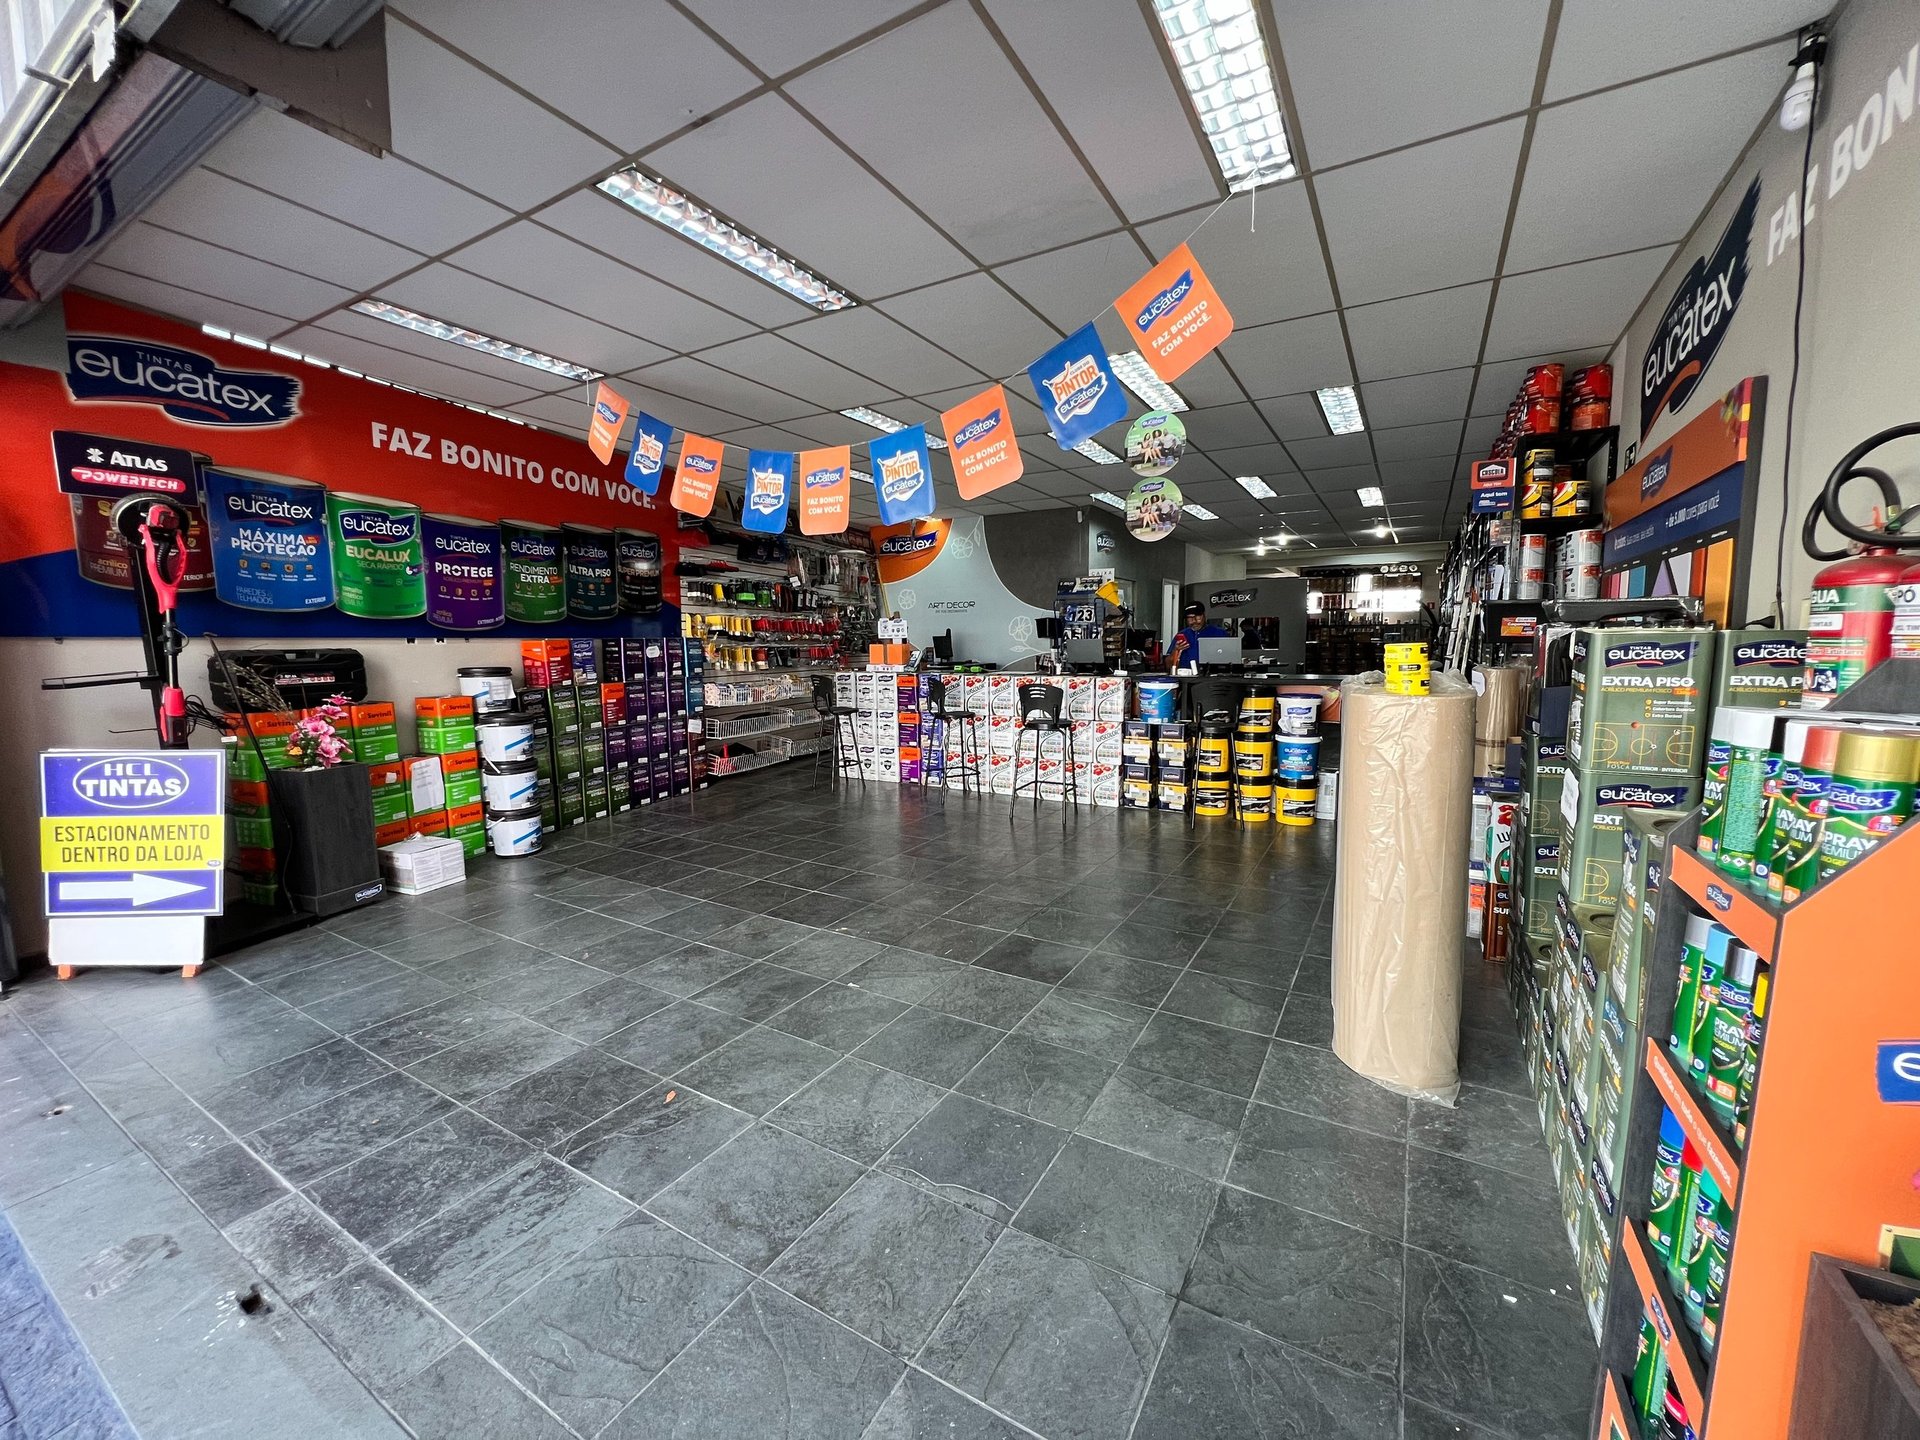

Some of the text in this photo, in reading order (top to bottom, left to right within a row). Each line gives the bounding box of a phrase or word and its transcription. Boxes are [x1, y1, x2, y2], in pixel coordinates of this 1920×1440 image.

[1767, 43, 1920, 266] FAZ BON
[1138, 281, 1190, 326] eucatex
[1152, 300, 1208, 348] FAZ BONITO
[1645, 256, 1737, 397] eucatex
[1160, 336, 1183, 357] COM
[137, 351, 193, 372] TINTAS
[75, 348, 275, 417] eucatex
[1053, 365, 1099, 402] PINTOR
[1060, 384, 1101, 415] eucatex
[955, 417, 998, 444] eucatex
[110, 451, 168, 471] ATLAS
[371, 421, 433, 461] FAZ
[440, 438, 545, 485] BONITO
[550, 467, 600, 497] COM
[960, 440, 1007, 468] FAZ BONITO
[806, 472, 841, 484] eucatex
[885, 462, 919, 483] PINTOR
[965, 463, 985, 477] COM
[82, 469, 179, 491] POWERTECH
[756, 480, 782, 494] PINTOR
[886, 478, 918, 493] eucatex
[228, 496, 313, 520] eucatex
[753, 496, 779, 505] eucatex
[343, 516, 411, 536] eucatex
[239, 528, 307, 546] MÁXIMA
[435, 537, 491, 554] eucatex
[882, 539, 932, 552] eucatex
[345, 544, 411, 563] EUCALUX
[510, 541, 556, 556] eucatex
[571, 545, 608, 558] eucatex
[621, 546, 655, 558] eucatex
[434, 562, 494, 578] PROTEGE
[509, 562, 558, 575] RENDIMENTO
[569, 564, 612, 577] ULTRA PISO
[520, 574, 550, 584] EXTRA
[1210, 593, 1251, 604] eucatex
[1810, 588, 1840, 603] GUA
[946, 601, 976, 609] DECOR
[1608, 647, 1686, 660] eucatex
[1601, 676, 1696, 688] EXTRA PISO
[1729, 676, 1789, 688] EXTRA
[367, 710, 393, 719] Suvinil
[103, 762, 160, 777] HCL
[80, 778, 182, 798] TINTAS
[1600, 788, 1676, 803] eucatex
[54, 824, 210, 842] ESTACIONAMENTO
[61, 844, 204, 863] DENTRO DA LOJA
